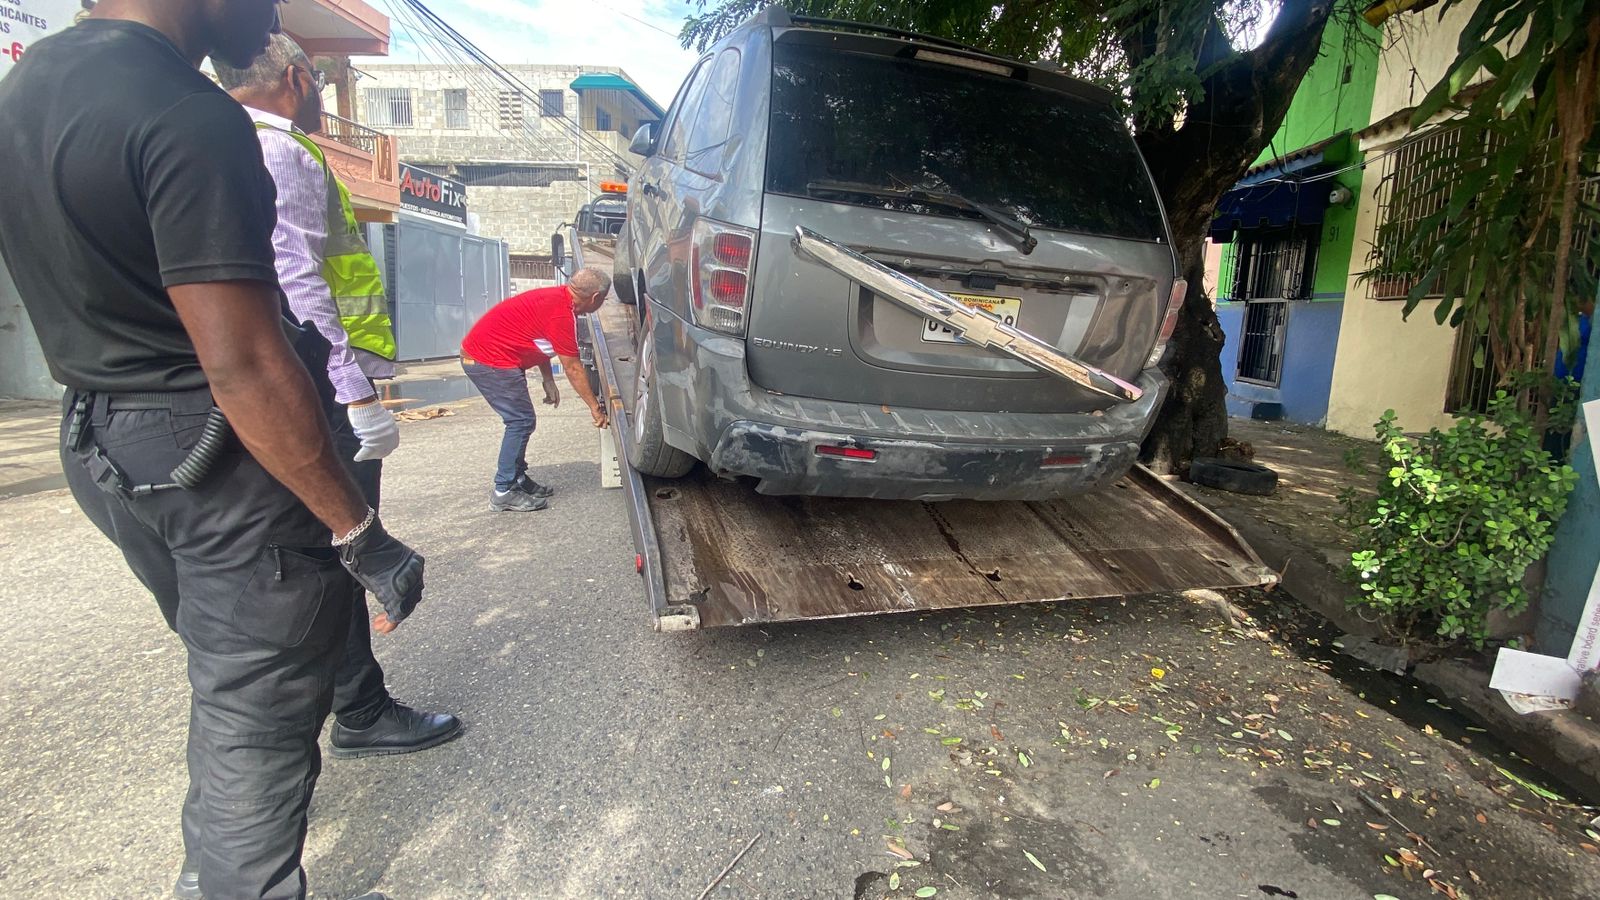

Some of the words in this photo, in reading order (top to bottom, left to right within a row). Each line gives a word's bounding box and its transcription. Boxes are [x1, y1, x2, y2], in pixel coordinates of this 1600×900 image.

[401, 170, 461, 208] AutoFix
[963, 297, 1000, 305] DOMINICANA
[753, 337, 819, 353] EQUINOX
[1584, 626, 1598, 650] board
